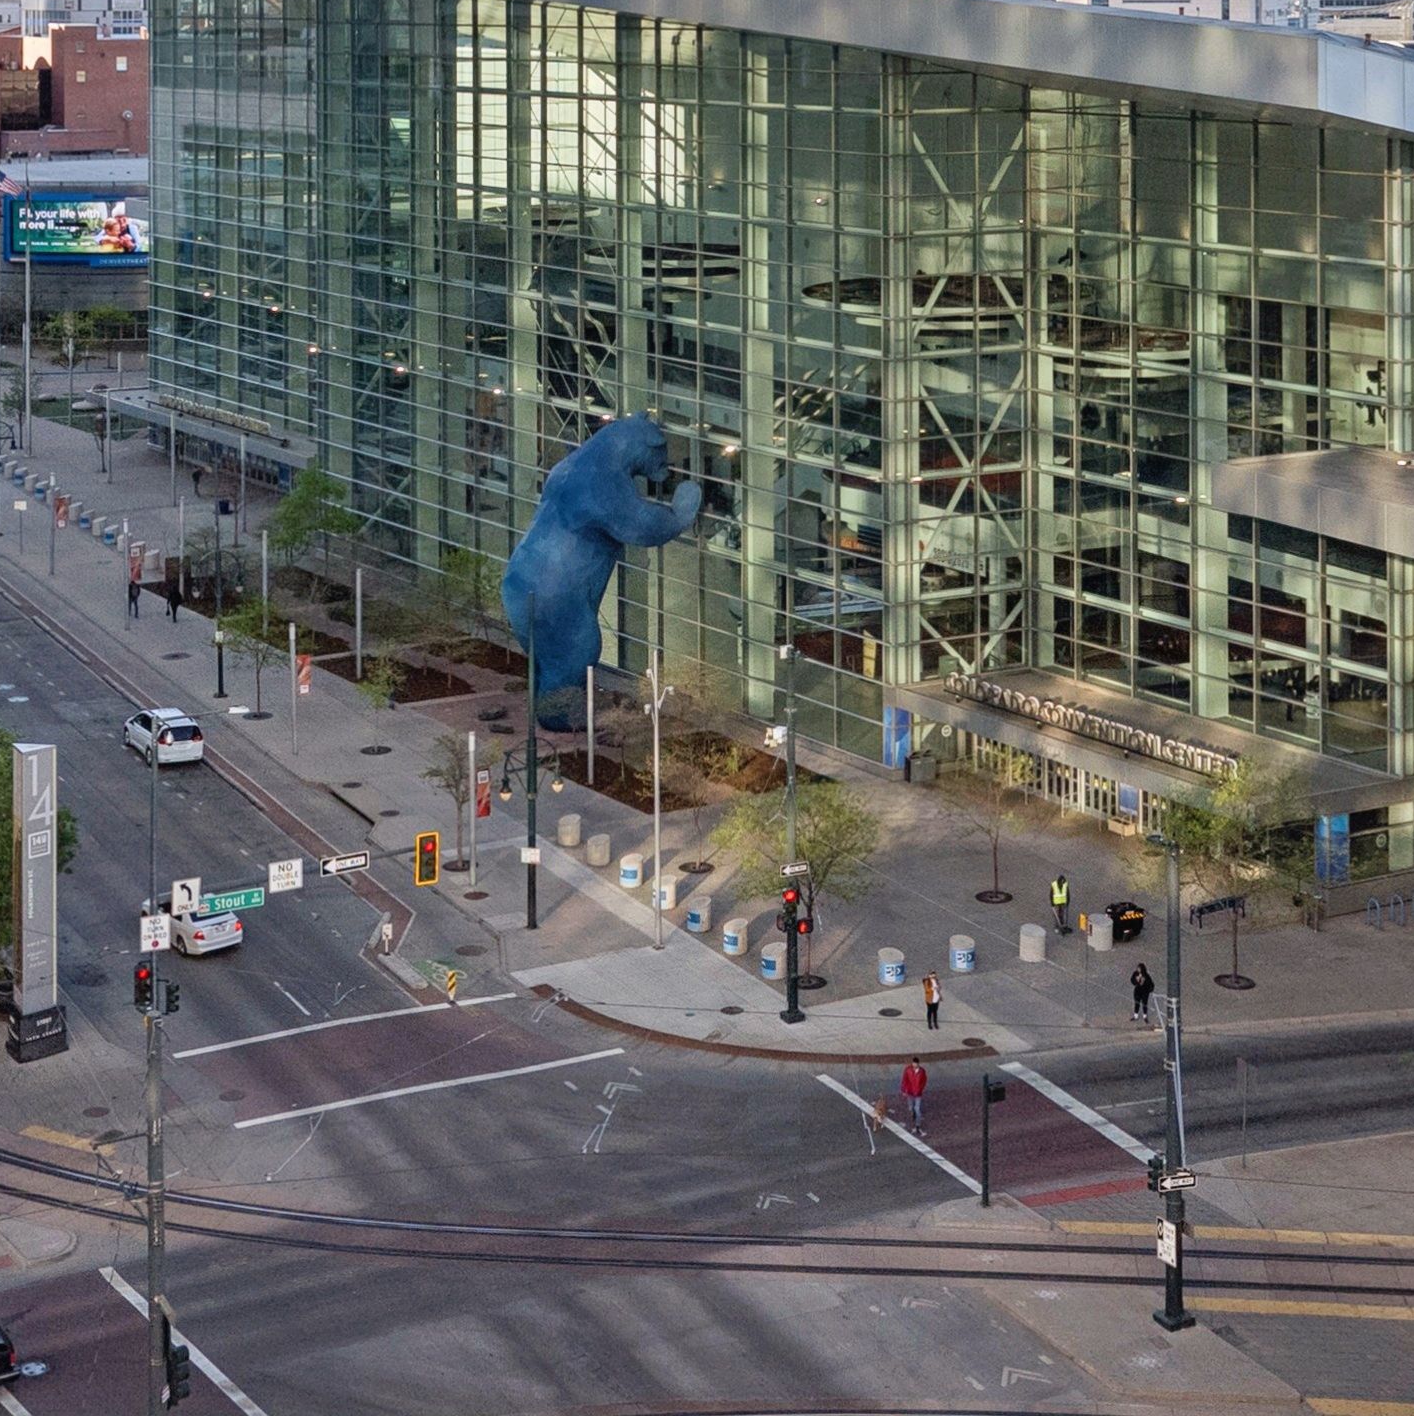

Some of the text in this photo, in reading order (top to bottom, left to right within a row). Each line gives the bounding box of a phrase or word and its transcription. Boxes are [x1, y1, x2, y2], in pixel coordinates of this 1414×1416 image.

[35, 210, 58, 220] your
[59, 208, 76, 219] life
[1041, 701, 1161, 756] CONVENTION
[1163, 739, 1238, 777] CENTER
[278, 863, 292, 873] NO
[177, 902, 194, 913] ONLY
[214, 893, 246, 911] Stout
